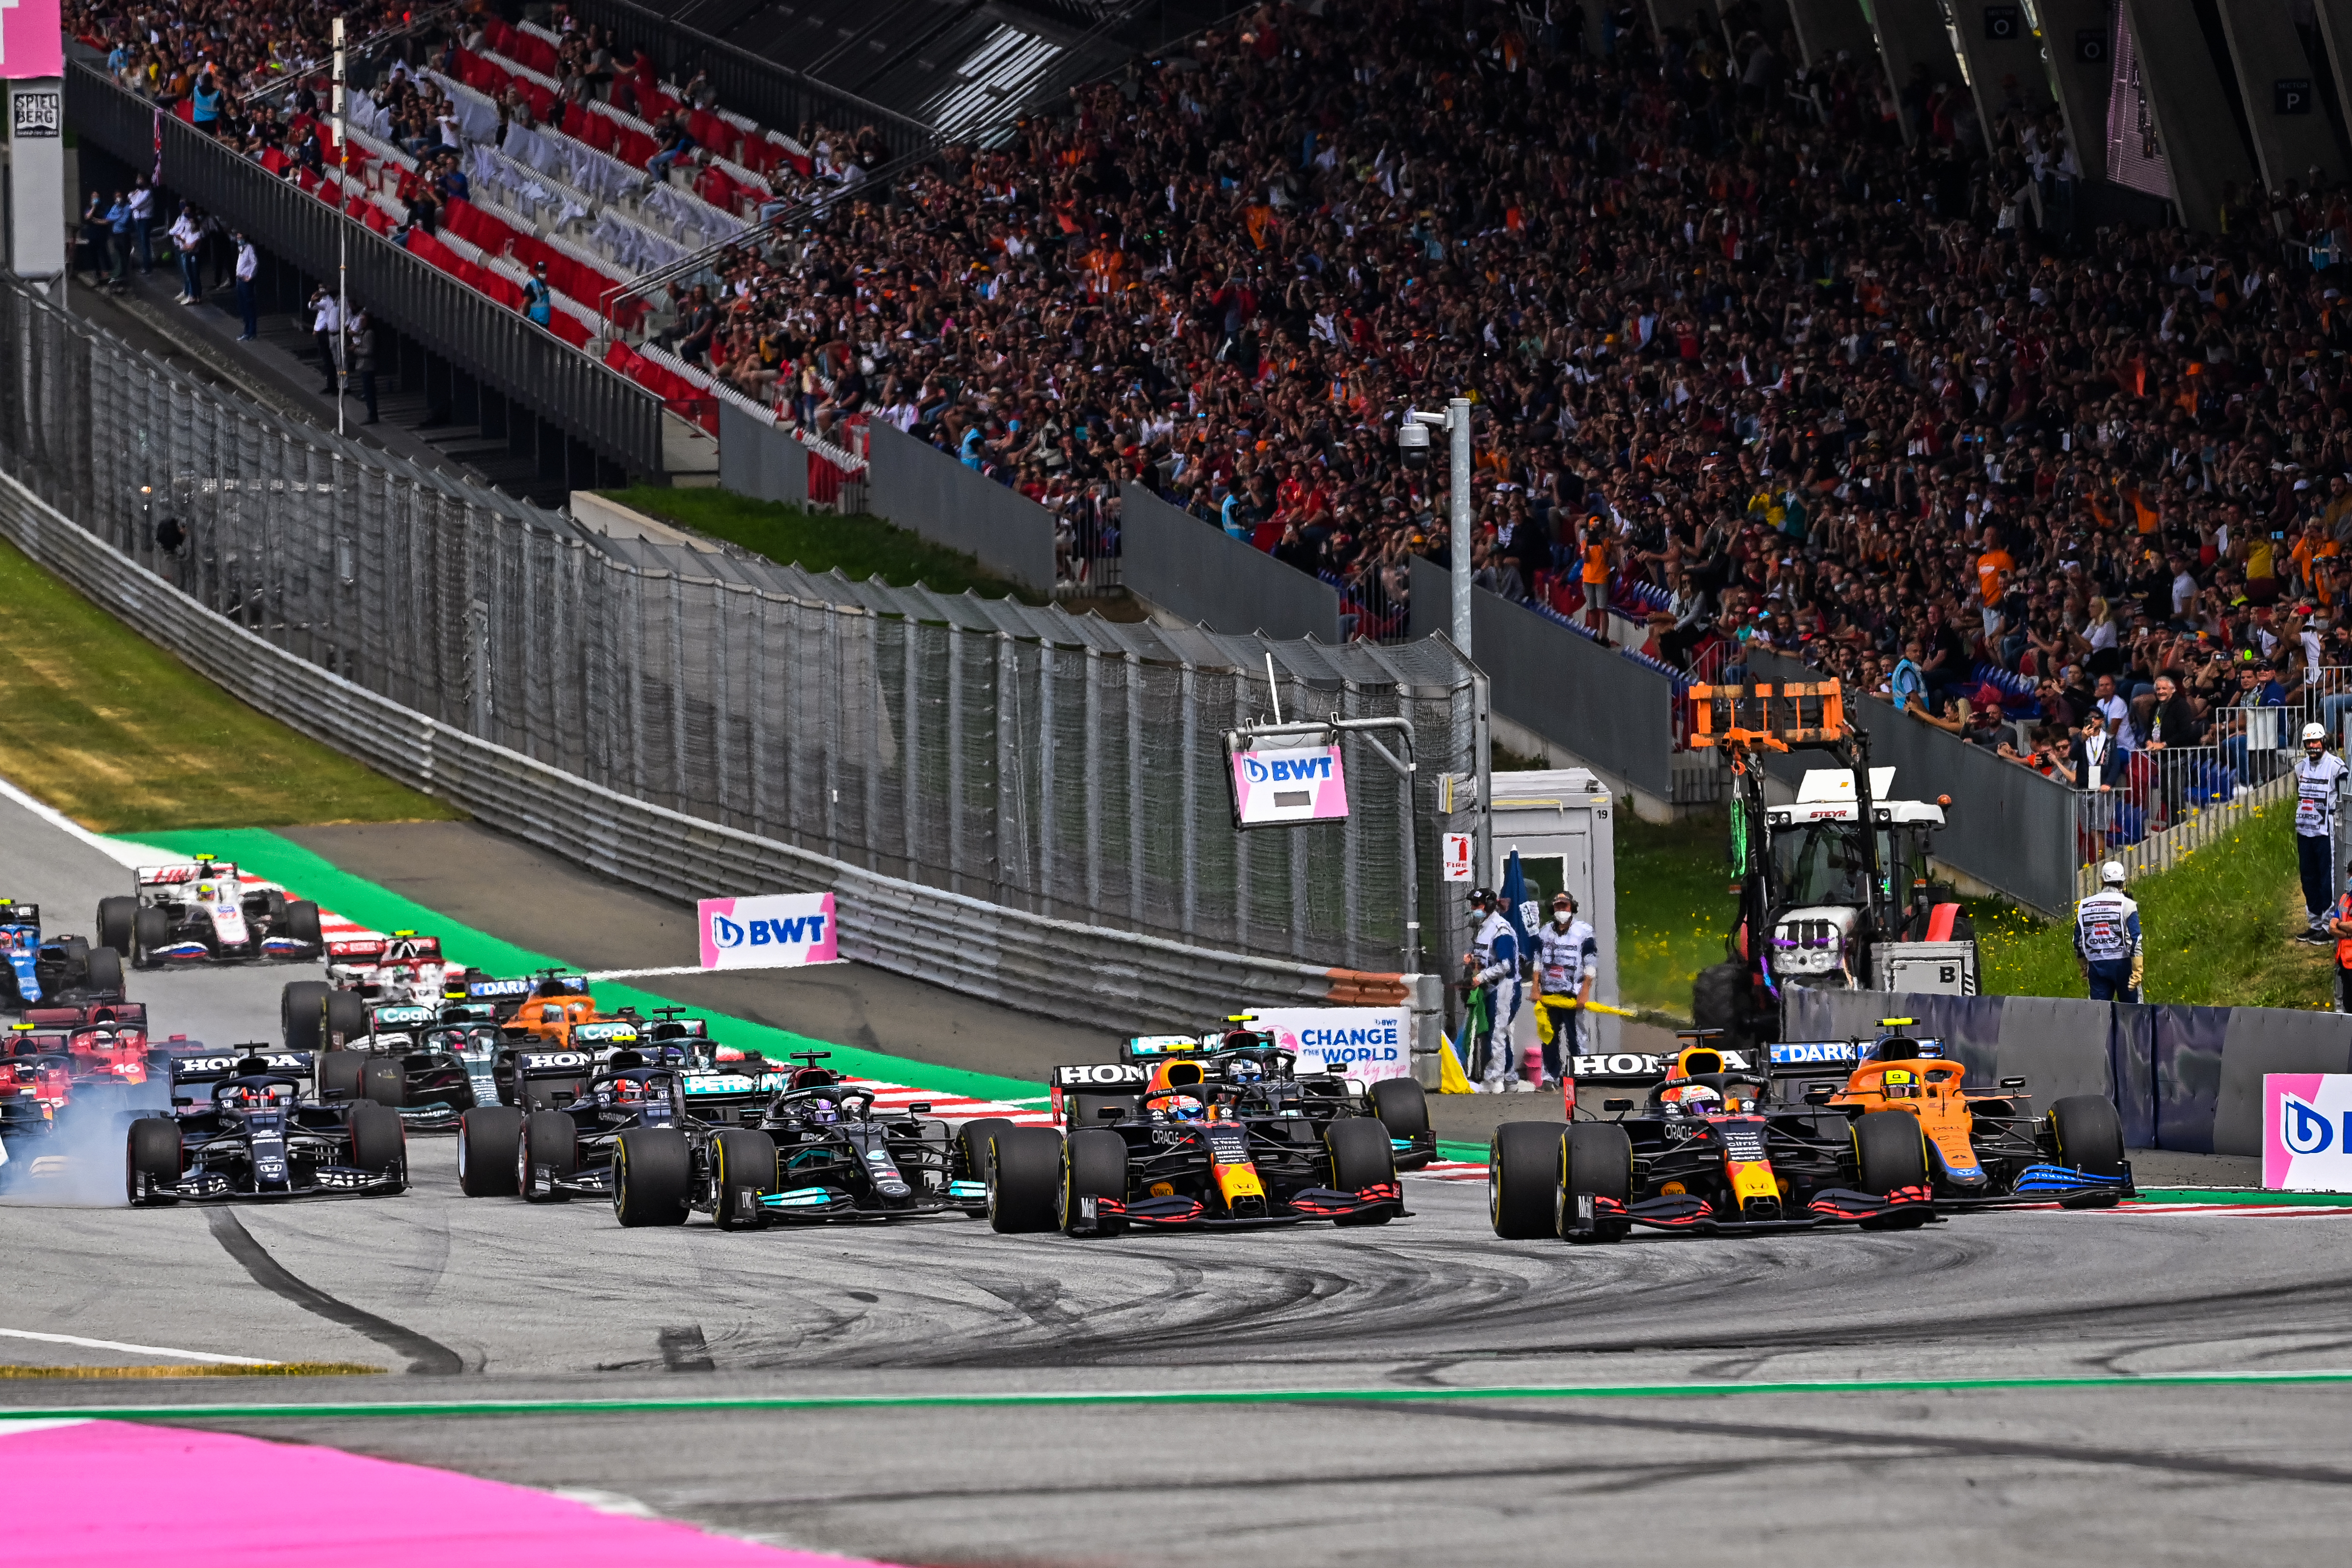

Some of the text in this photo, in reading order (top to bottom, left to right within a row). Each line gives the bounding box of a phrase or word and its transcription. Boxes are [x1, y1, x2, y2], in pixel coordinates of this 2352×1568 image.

[15, 94, 58, 109] SPIEL
[2287, 93, 2300, 109] P
[15, 110, 53, 123] BERG
[1272, 757, 1332, 781] BWT
[1596, 809, 1608, 819] 19
[750, 916, 825, 945] BWT
[1939, 966, 1956, 983] B
[1301, 1029, 1397, 1045] CHANGE
[1323, 1048, 1397, 1063] WORLD
[114, 1063, 140, 1074] 16
[1152, 1130, 1179, 1145] ORACLE
[1665, 1124, 1692, 1141] ORACLE
